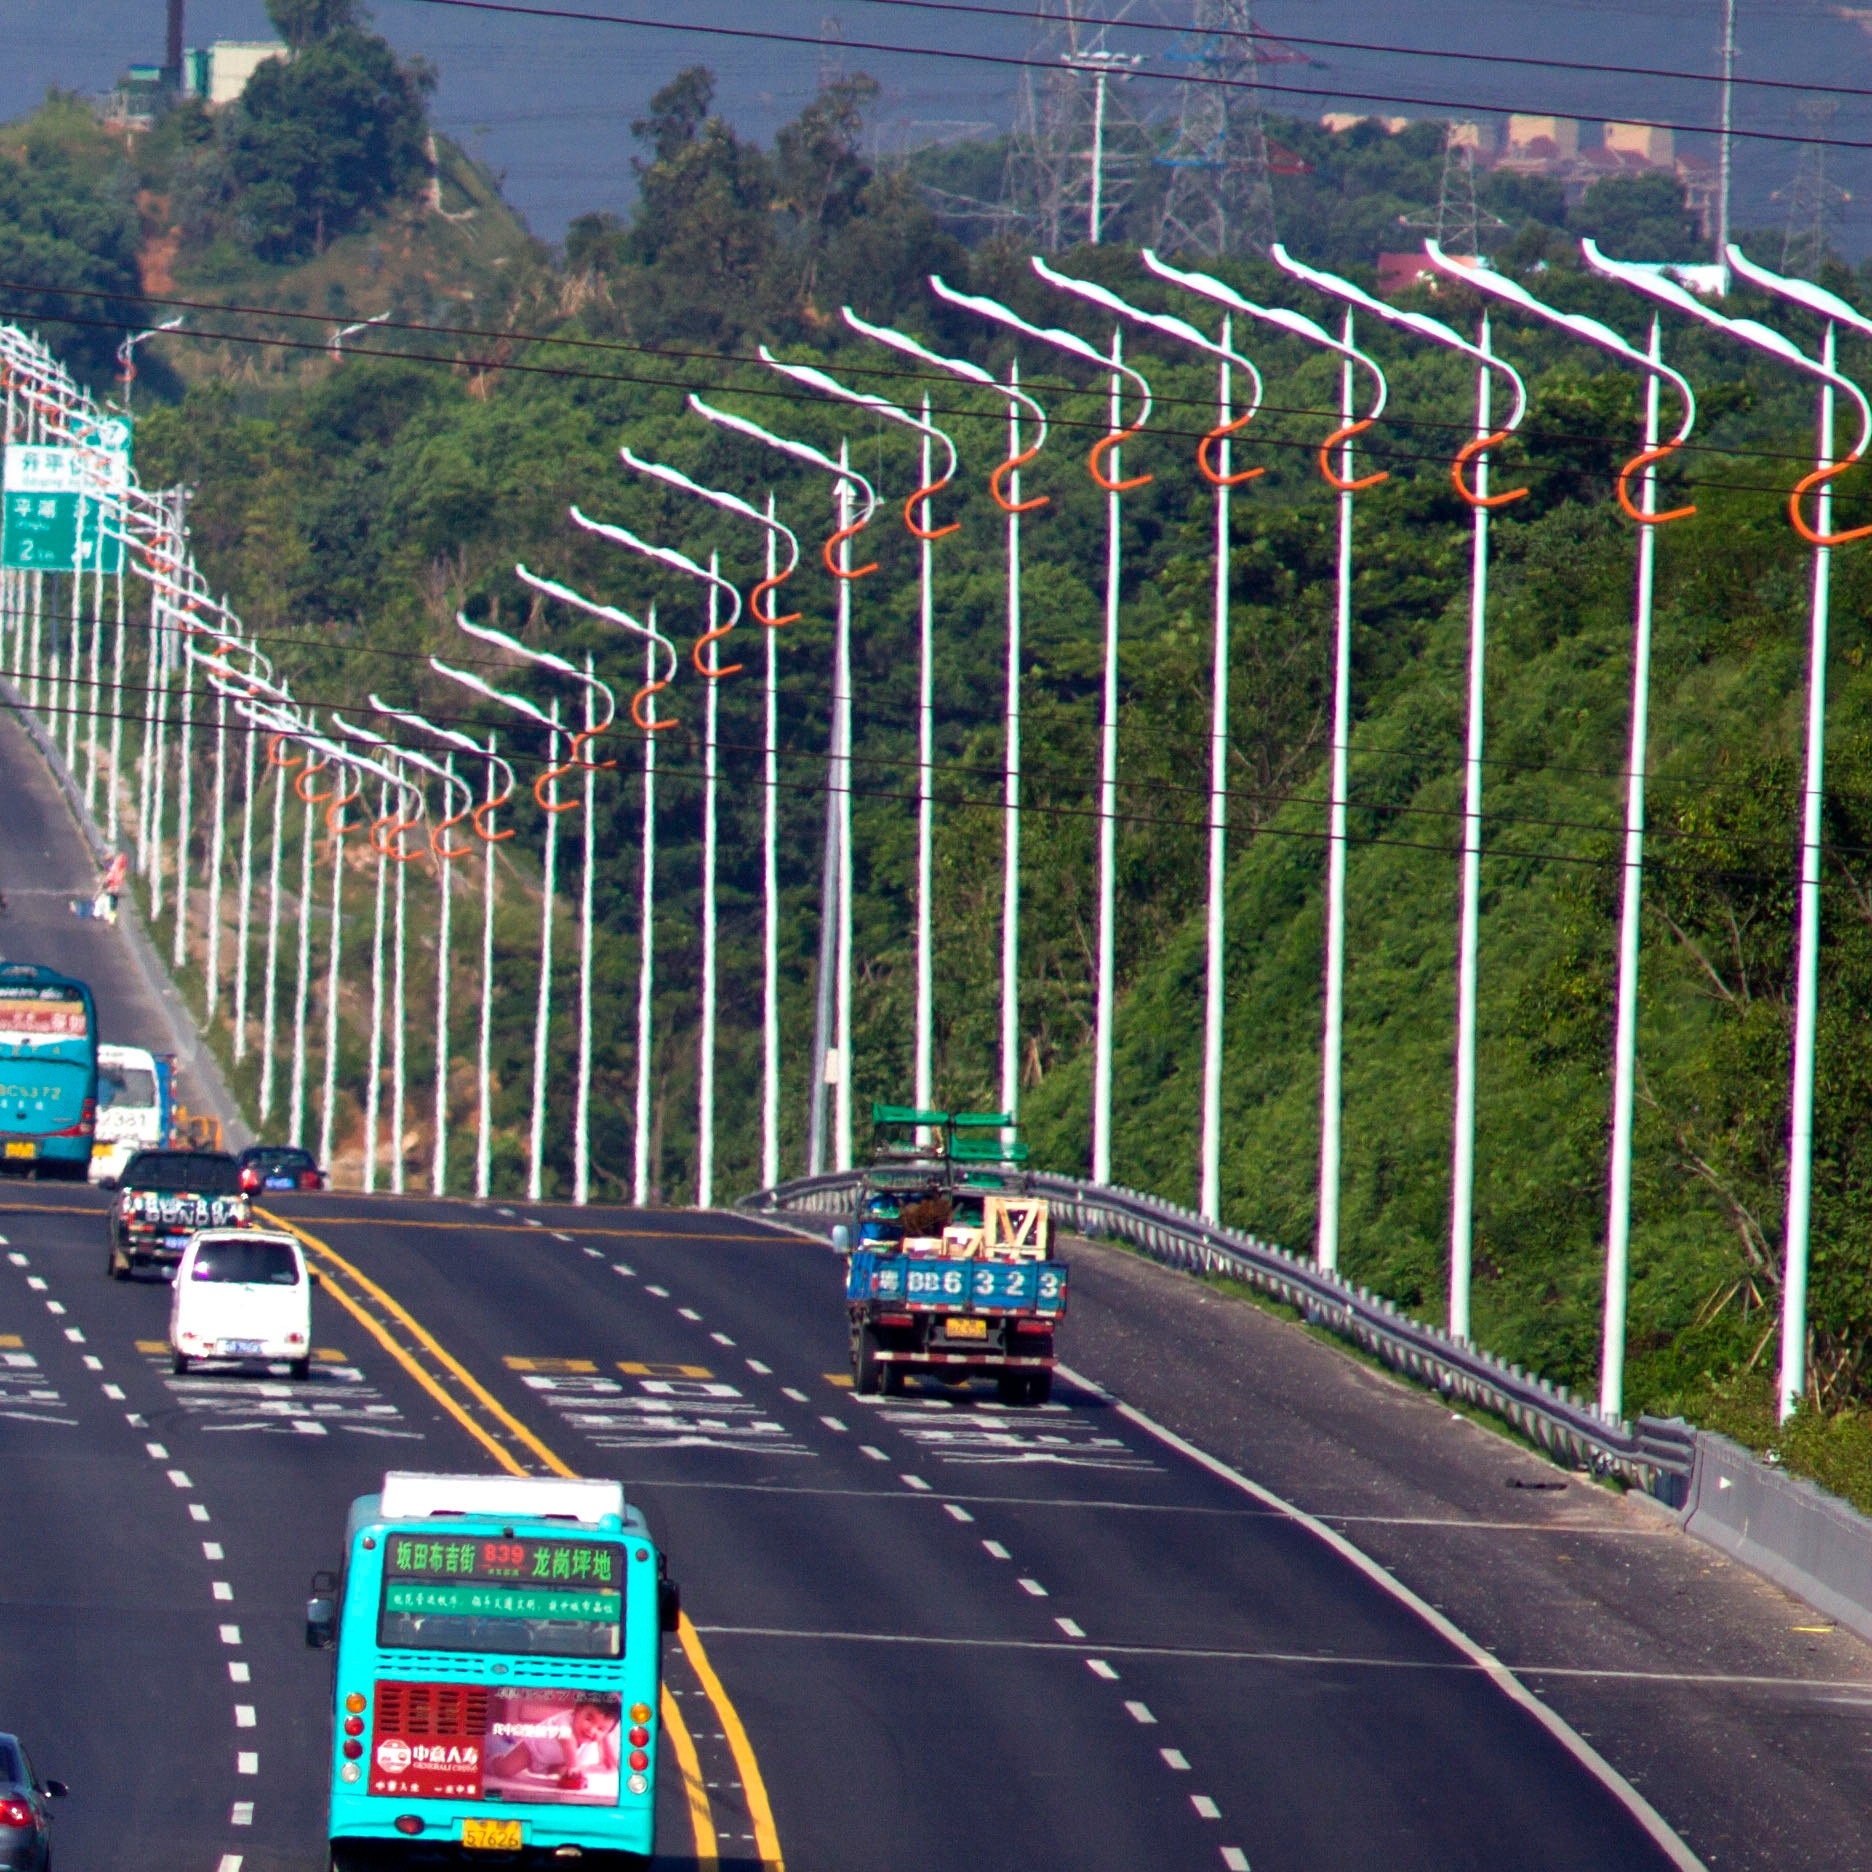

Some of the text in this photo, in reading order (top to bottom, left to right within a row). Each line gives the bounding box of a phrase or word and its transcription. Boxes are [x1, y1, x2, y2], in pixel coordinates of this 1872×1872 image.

[20, 540, 33, 561] 2
[397, 1541, 611, 1580] 坂田布吉街 839 龙岗坪地
[466, 1830, 520, 1848] 57626
